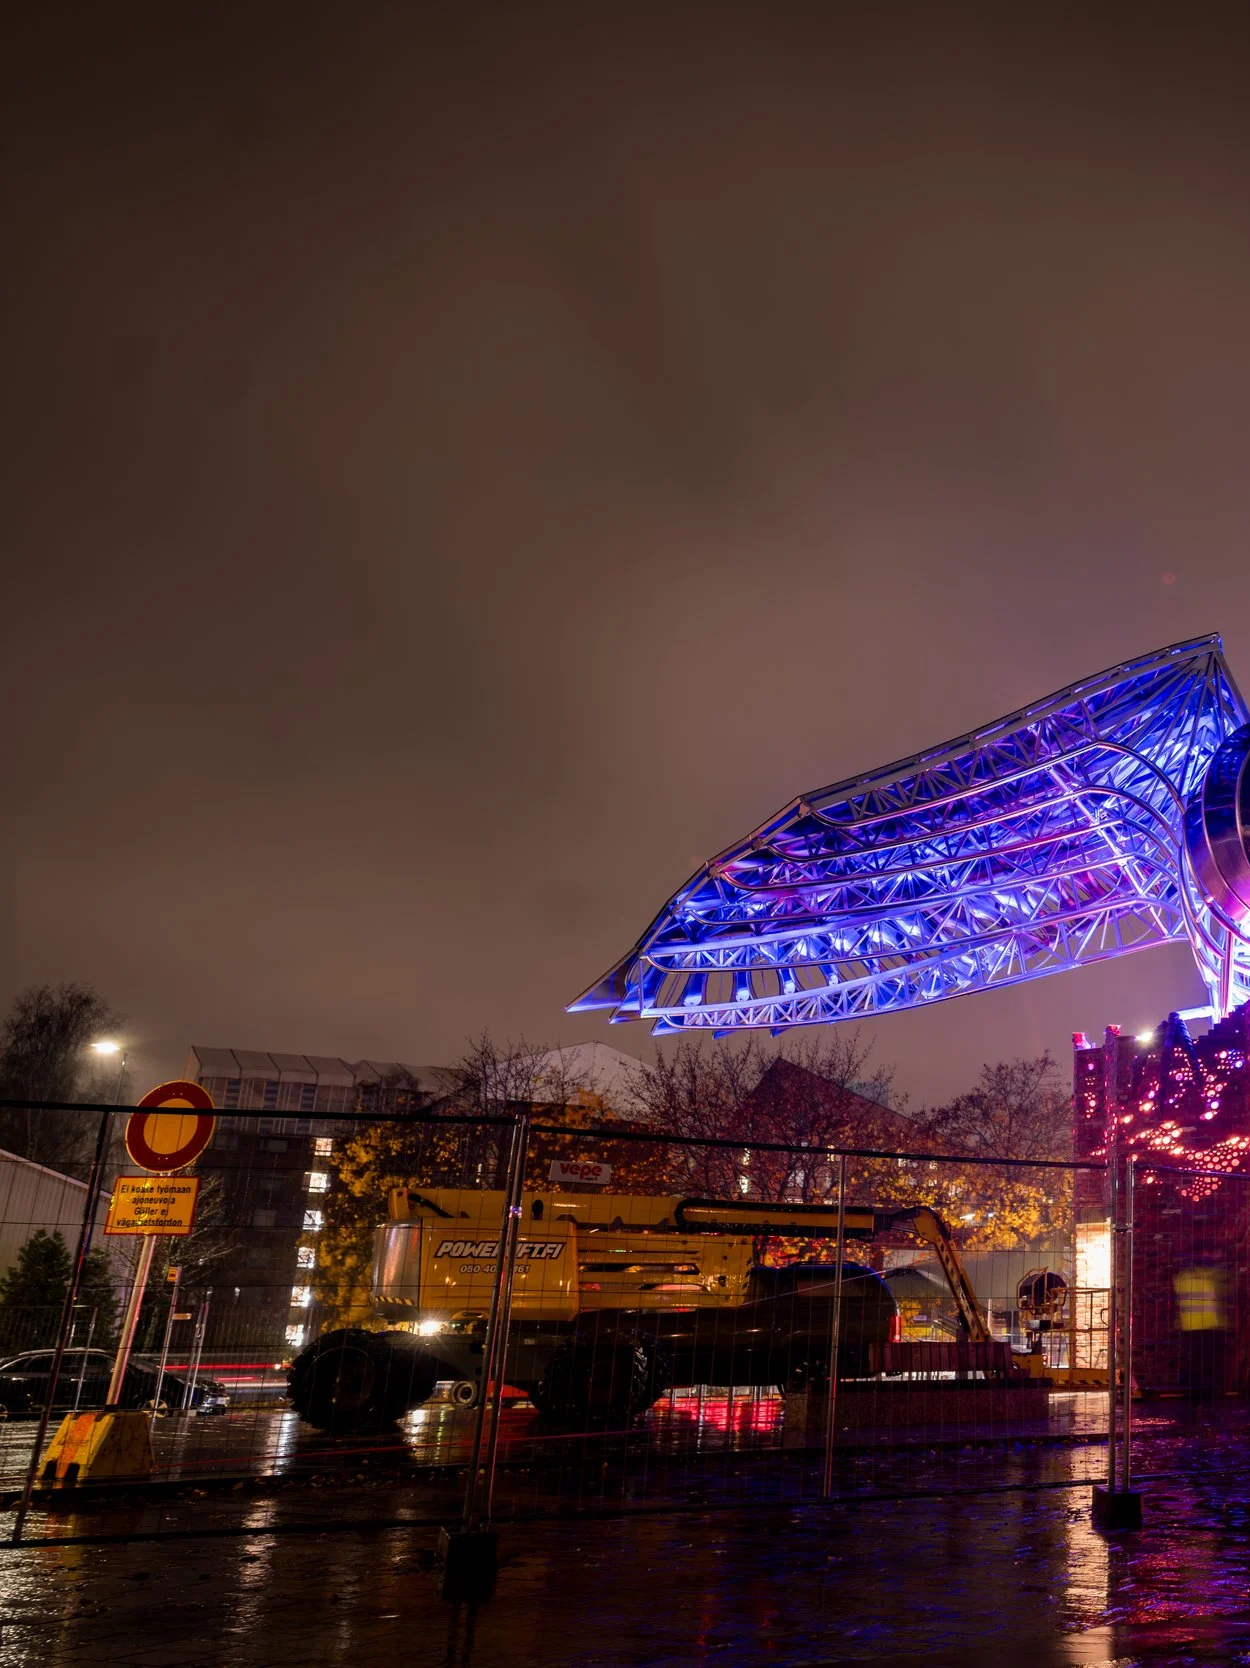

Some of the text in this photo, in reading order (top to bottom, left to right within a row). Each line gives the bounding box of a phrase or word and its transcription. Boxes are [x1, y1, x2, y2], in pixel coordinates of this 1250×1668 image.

[559, 1162, 602, 1180] vepe
[121, 1185, 129, 1194] Ei
[157, 1185, 191, 1194] työmaan
[132, 1196, 175, 1205] ajoneuvoja
[116, 1219, 182, 1228] vägaetsfordon
[434, 1240, 567, 1260] POWEIFT.FI
[460, 1264, 481, 1274] 050
